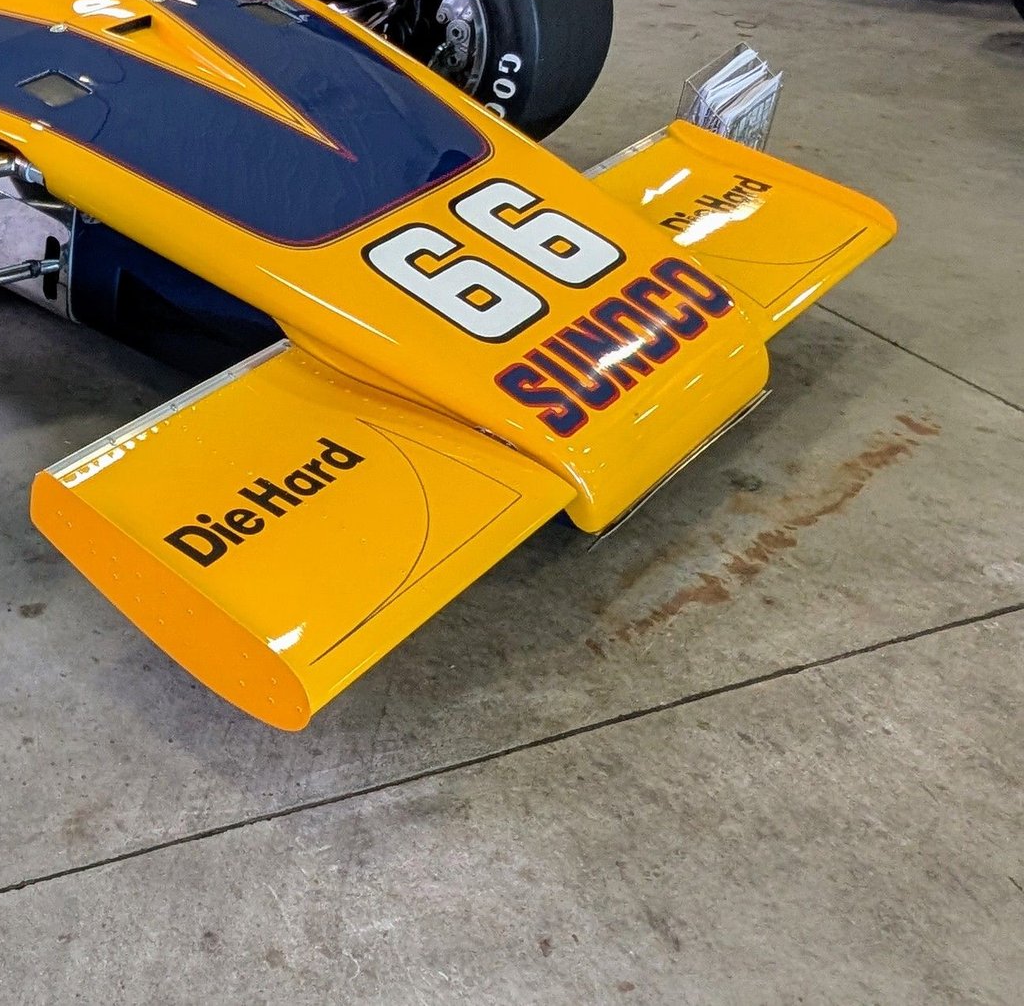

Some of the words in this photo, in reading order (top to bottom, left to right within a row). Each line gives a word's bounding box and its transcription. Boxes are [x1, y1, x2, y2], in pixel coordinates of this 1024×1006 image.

[360, 177, 628, 345] 66
[493, 256, 736, 439] SUNOCO
[163, 436, 366, 568] DieHard
